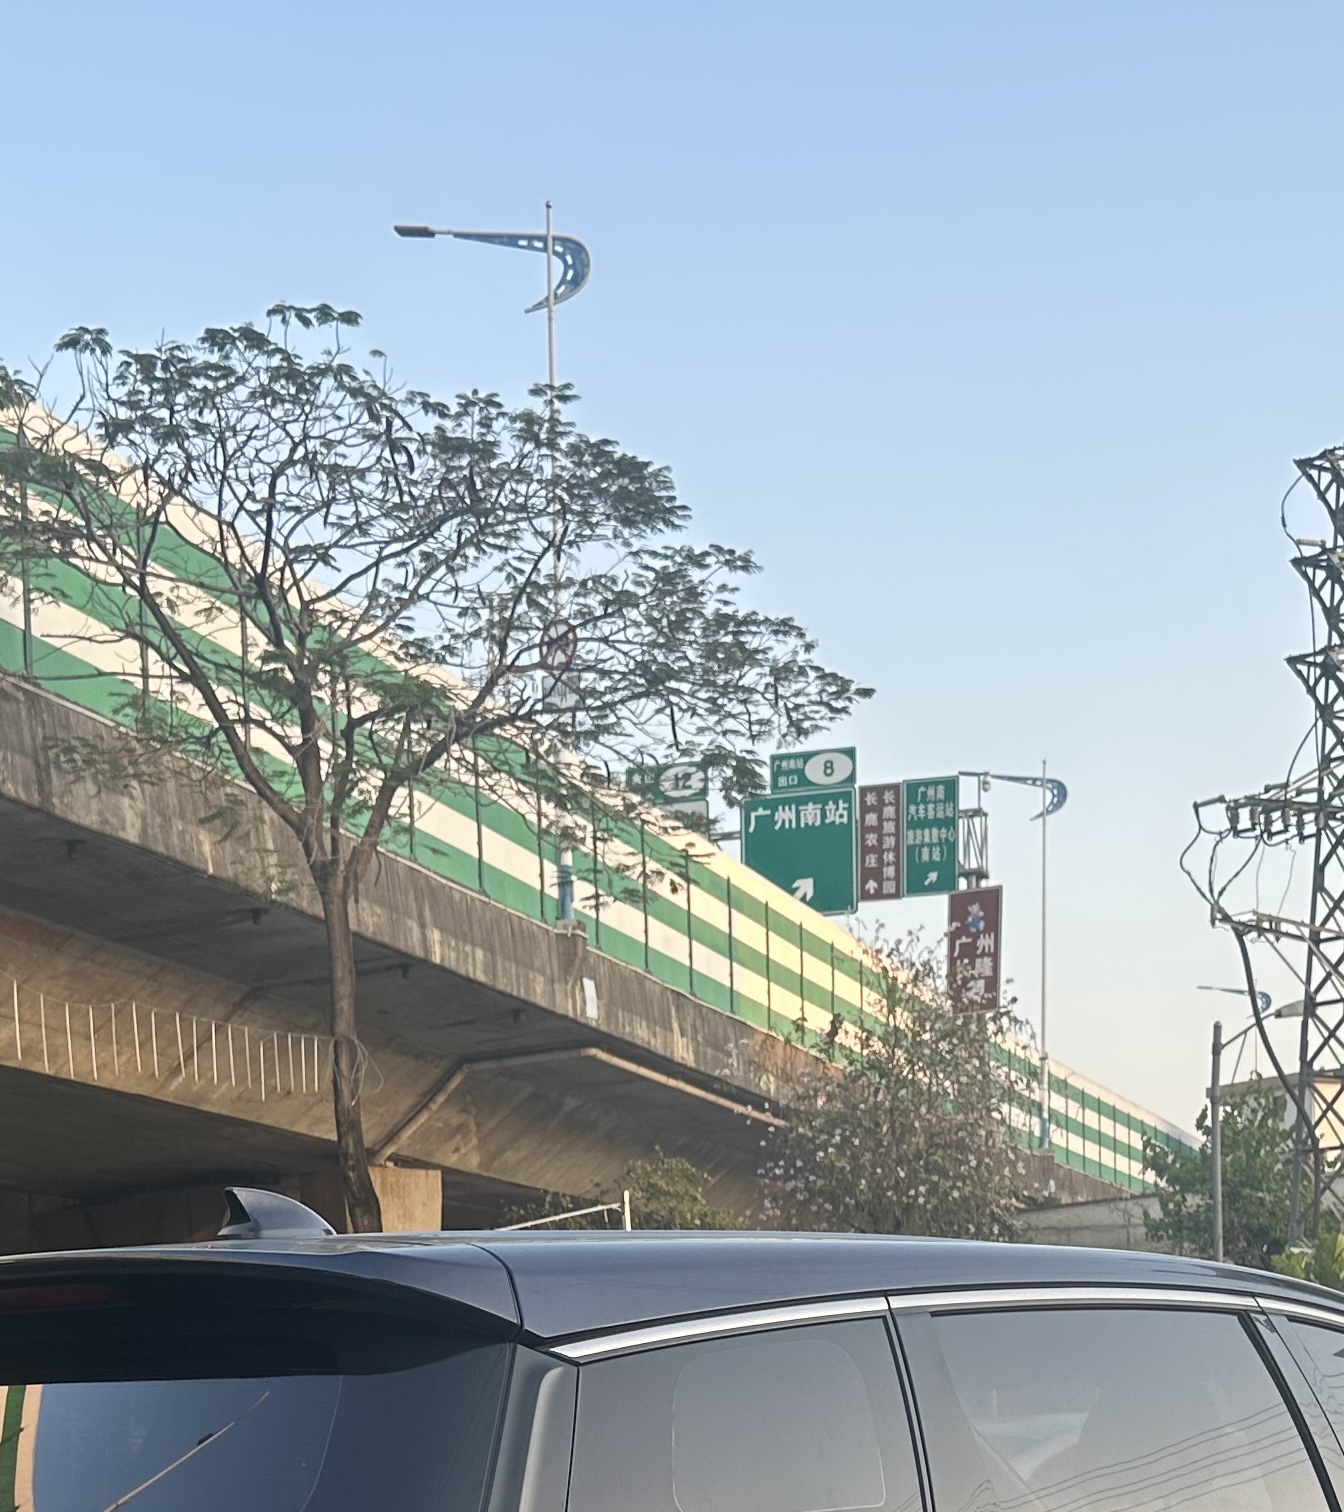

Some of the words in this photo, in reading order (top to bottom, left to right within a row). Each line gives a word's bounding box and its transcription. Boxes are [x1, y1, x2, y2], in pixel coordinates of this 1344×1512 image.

[773, 758, 804, 772] 广州南站
[823, 760, 834, 777] 8
[778, 776, 798, 787] 出口
[748, 799, 849, 833] 广州南站
[953, 932, 994, 957] 广州
